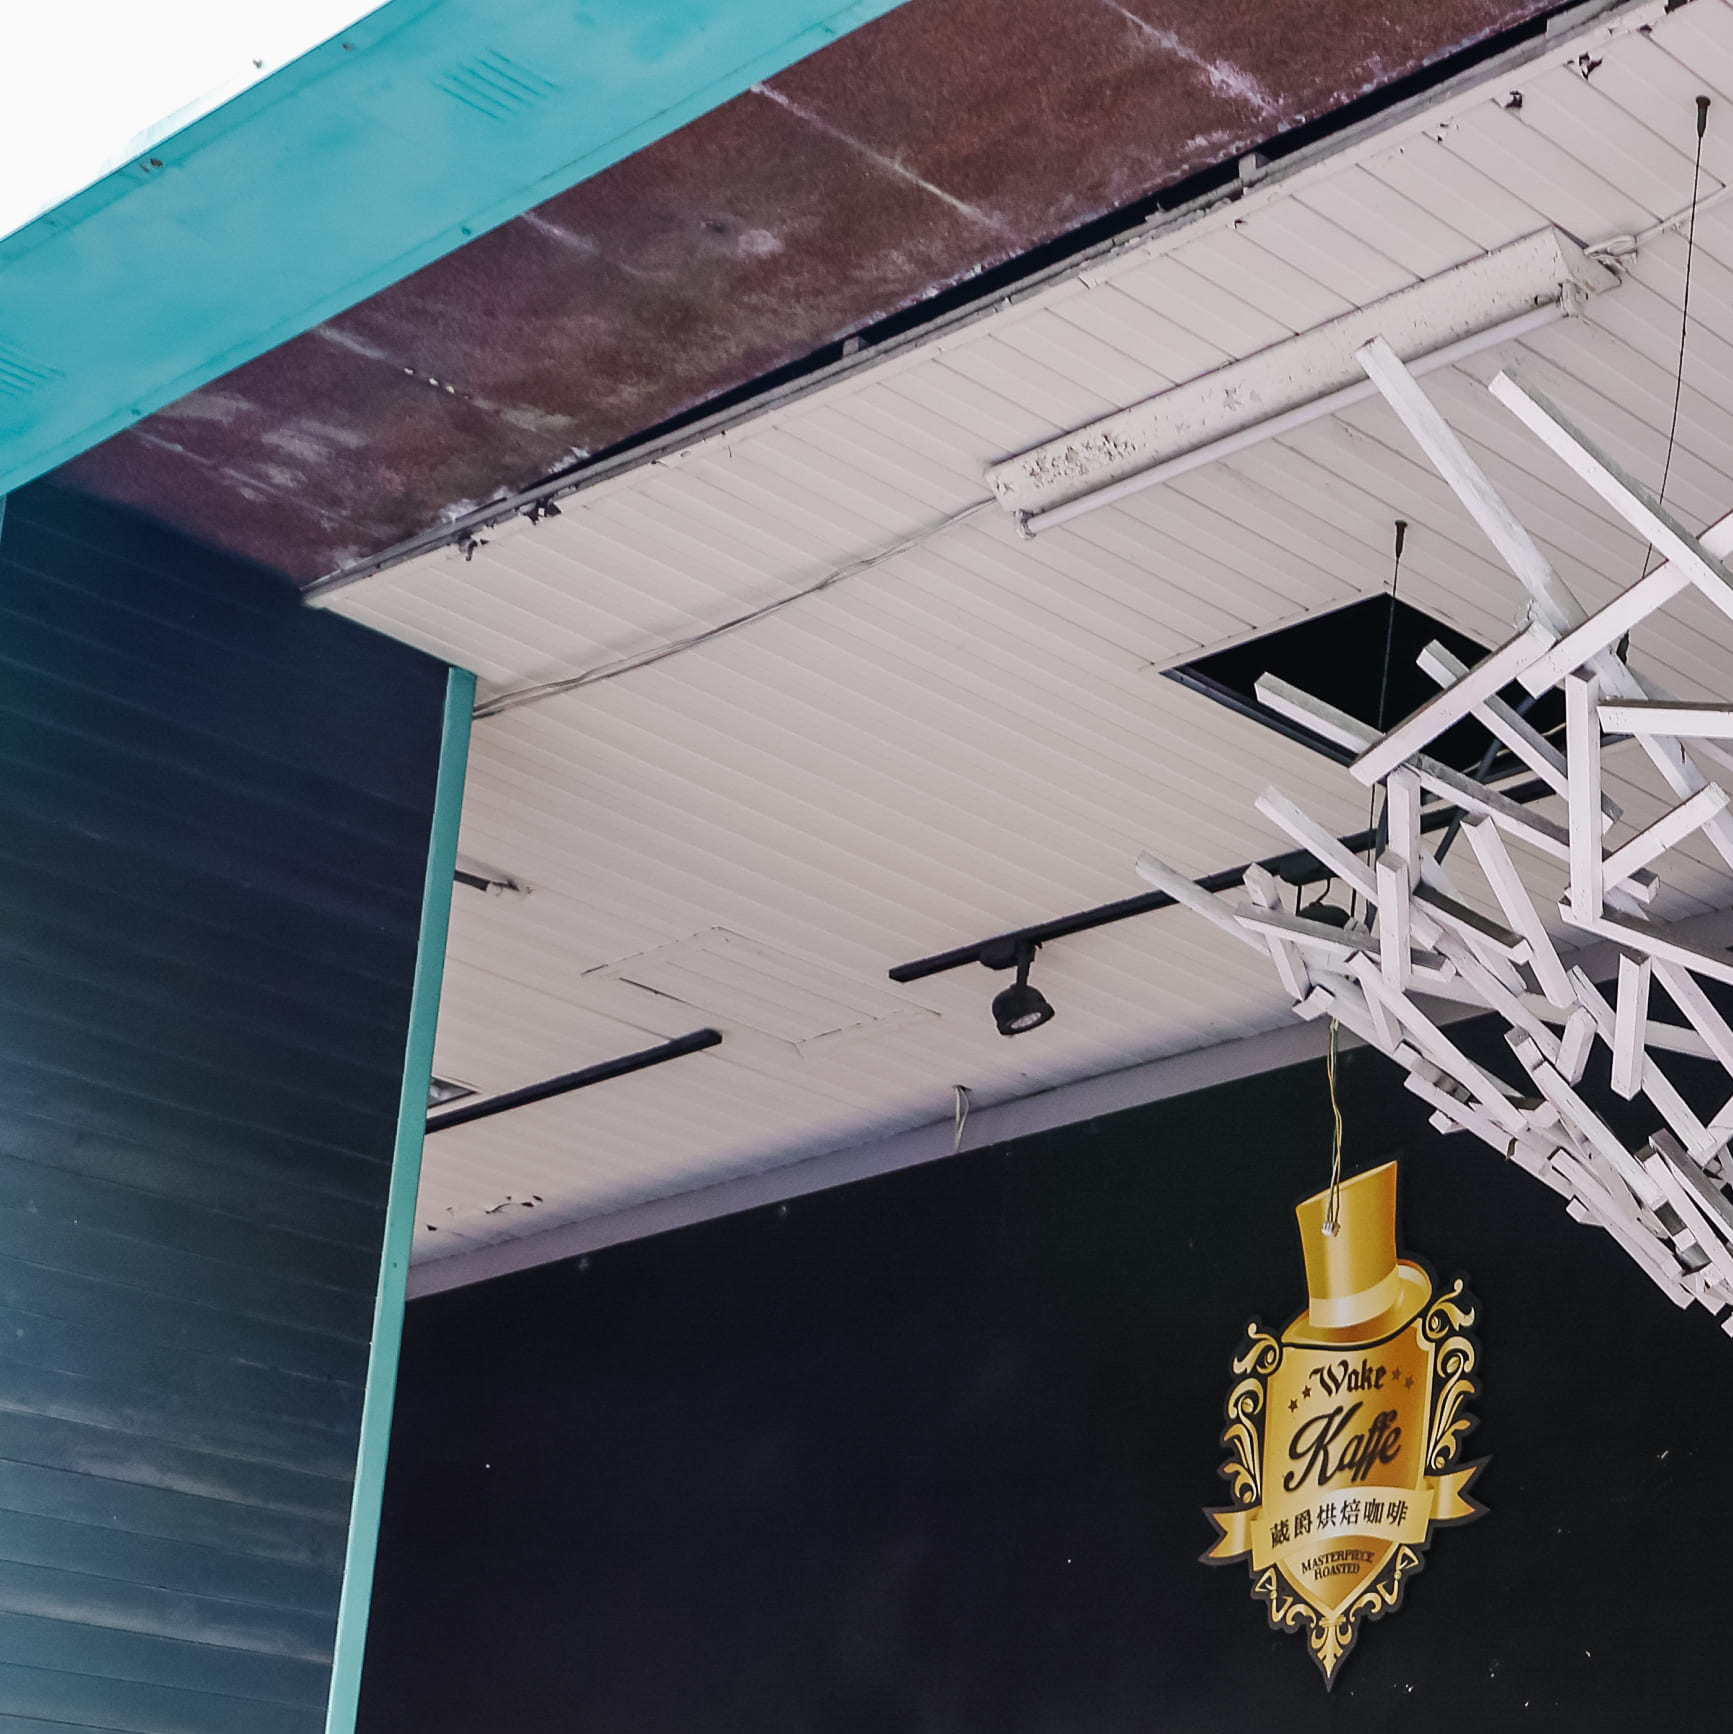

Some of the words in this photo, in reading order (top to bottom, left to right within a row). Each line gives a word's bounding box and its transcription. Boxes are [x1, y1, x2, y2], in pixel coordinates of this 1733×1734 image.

[1309, 1358, 1387, 1398] Wake
[1283, 1401, 1402, 1492] Kaffe
[1301, 1550, 1375, 1574] MASTERPIECE
[1314, 1563, 1361, 1580] ROASTED
